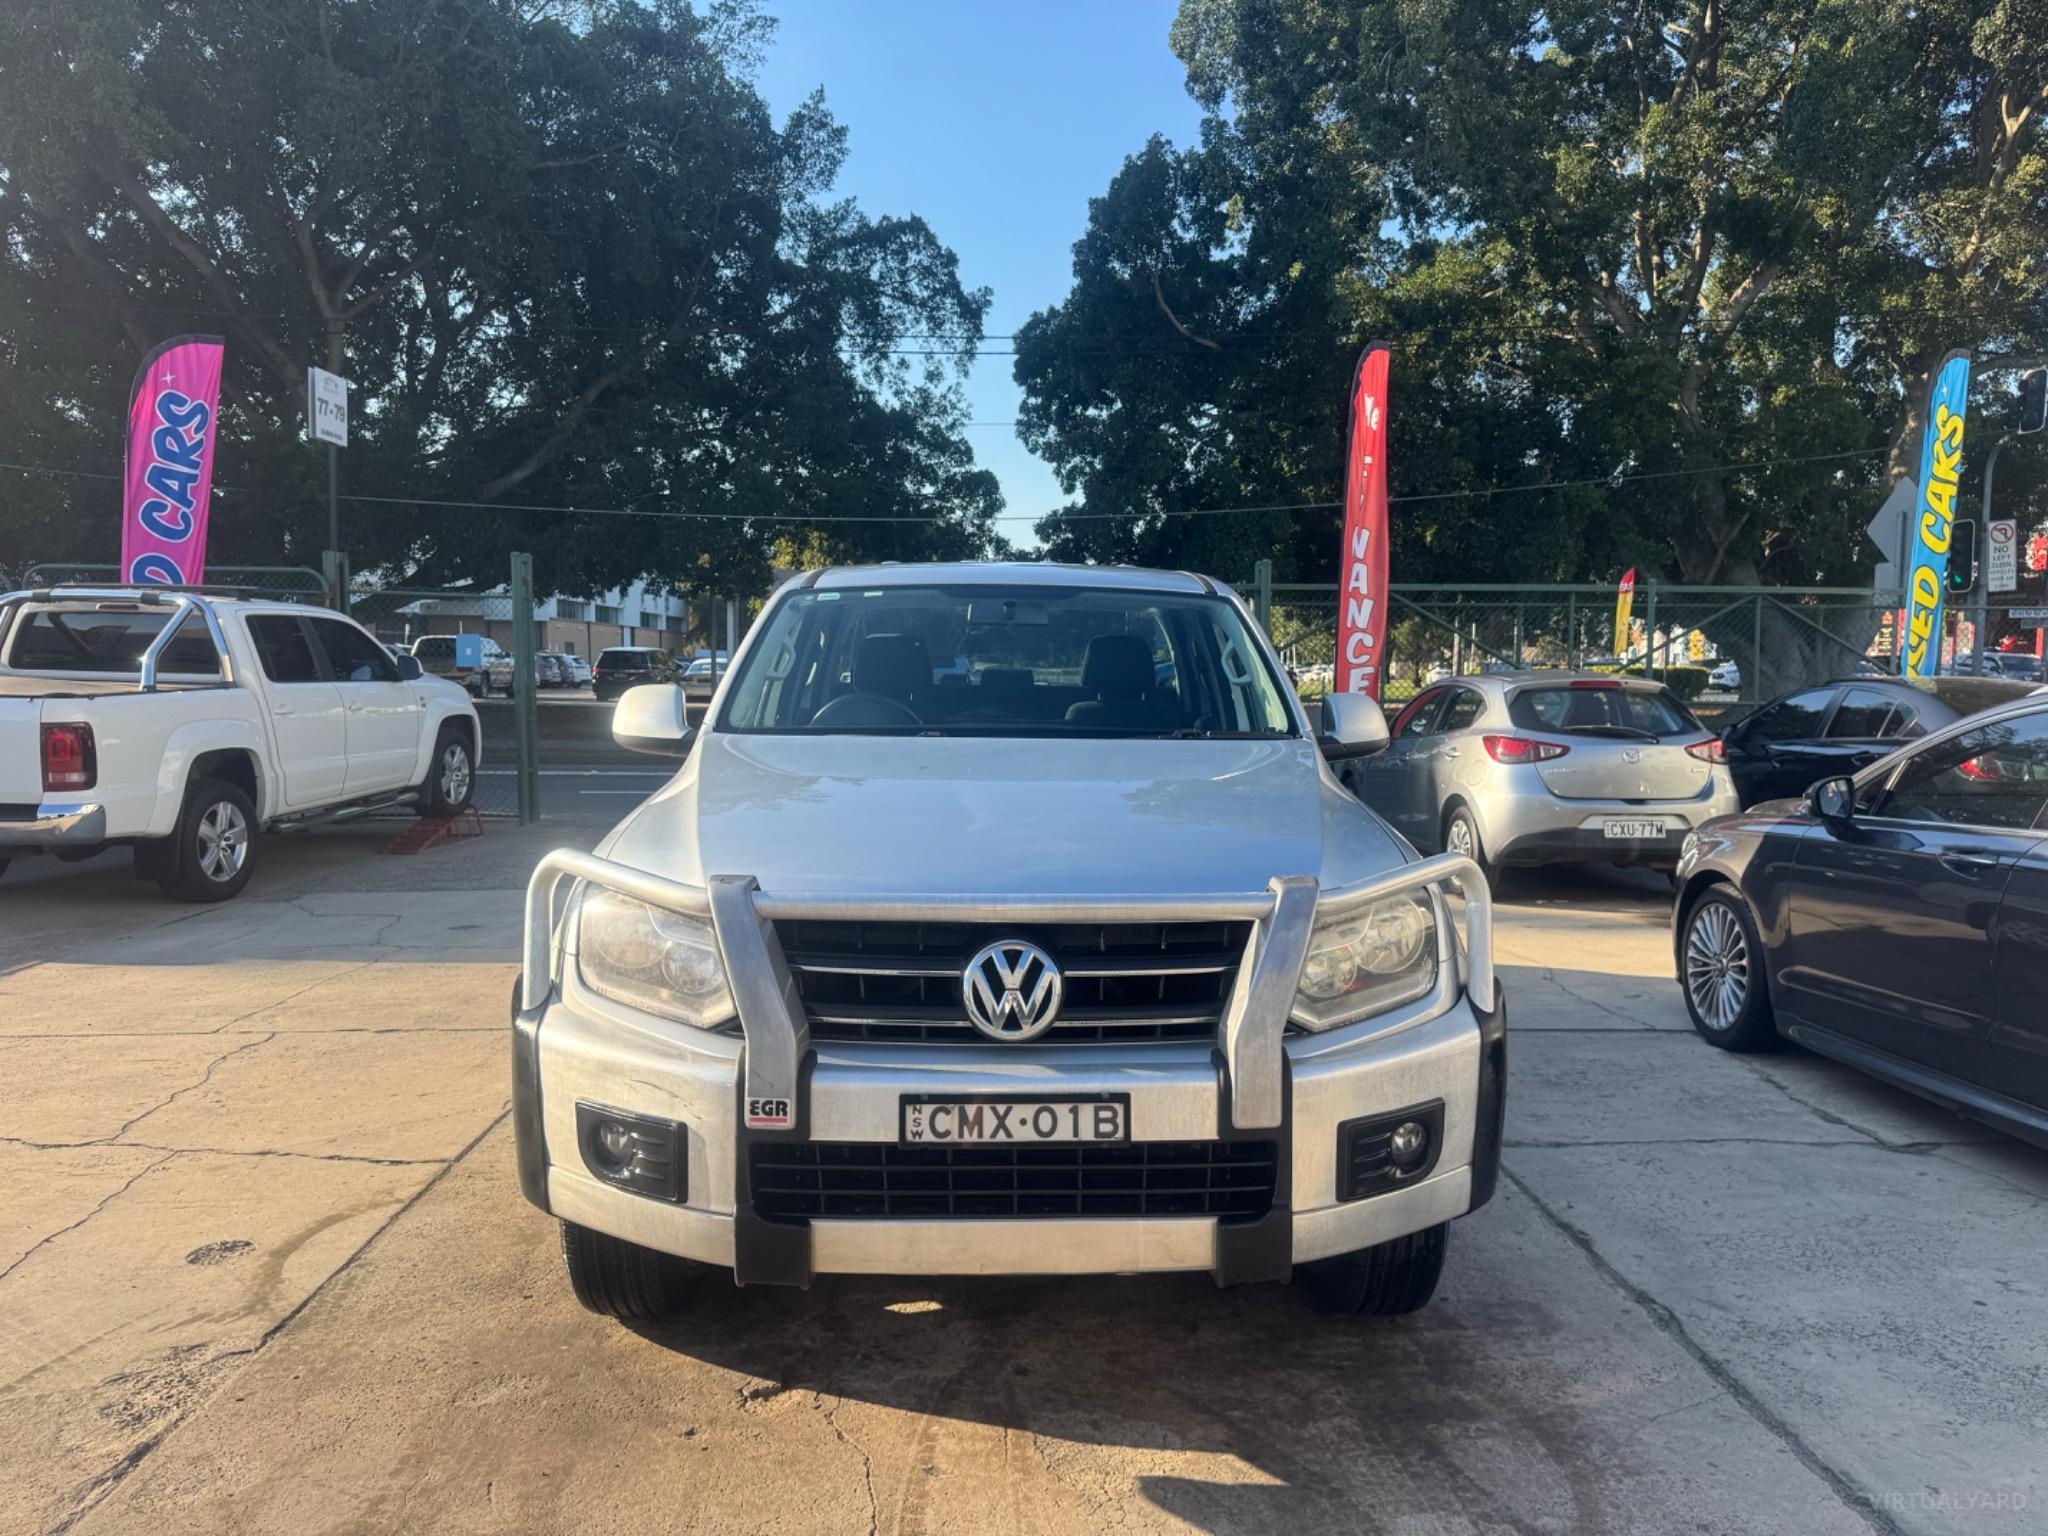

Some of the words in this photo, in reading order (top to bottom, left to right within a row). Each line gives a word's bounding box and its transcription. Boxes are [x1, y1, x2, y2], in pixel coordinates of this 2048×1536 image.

[138, 389, 210, 543] CARS
[1919, 402, 1965, 555] CARS
[1993, 545, 2009, 554] NO
[749, 1099, 788, 1117] EGR
